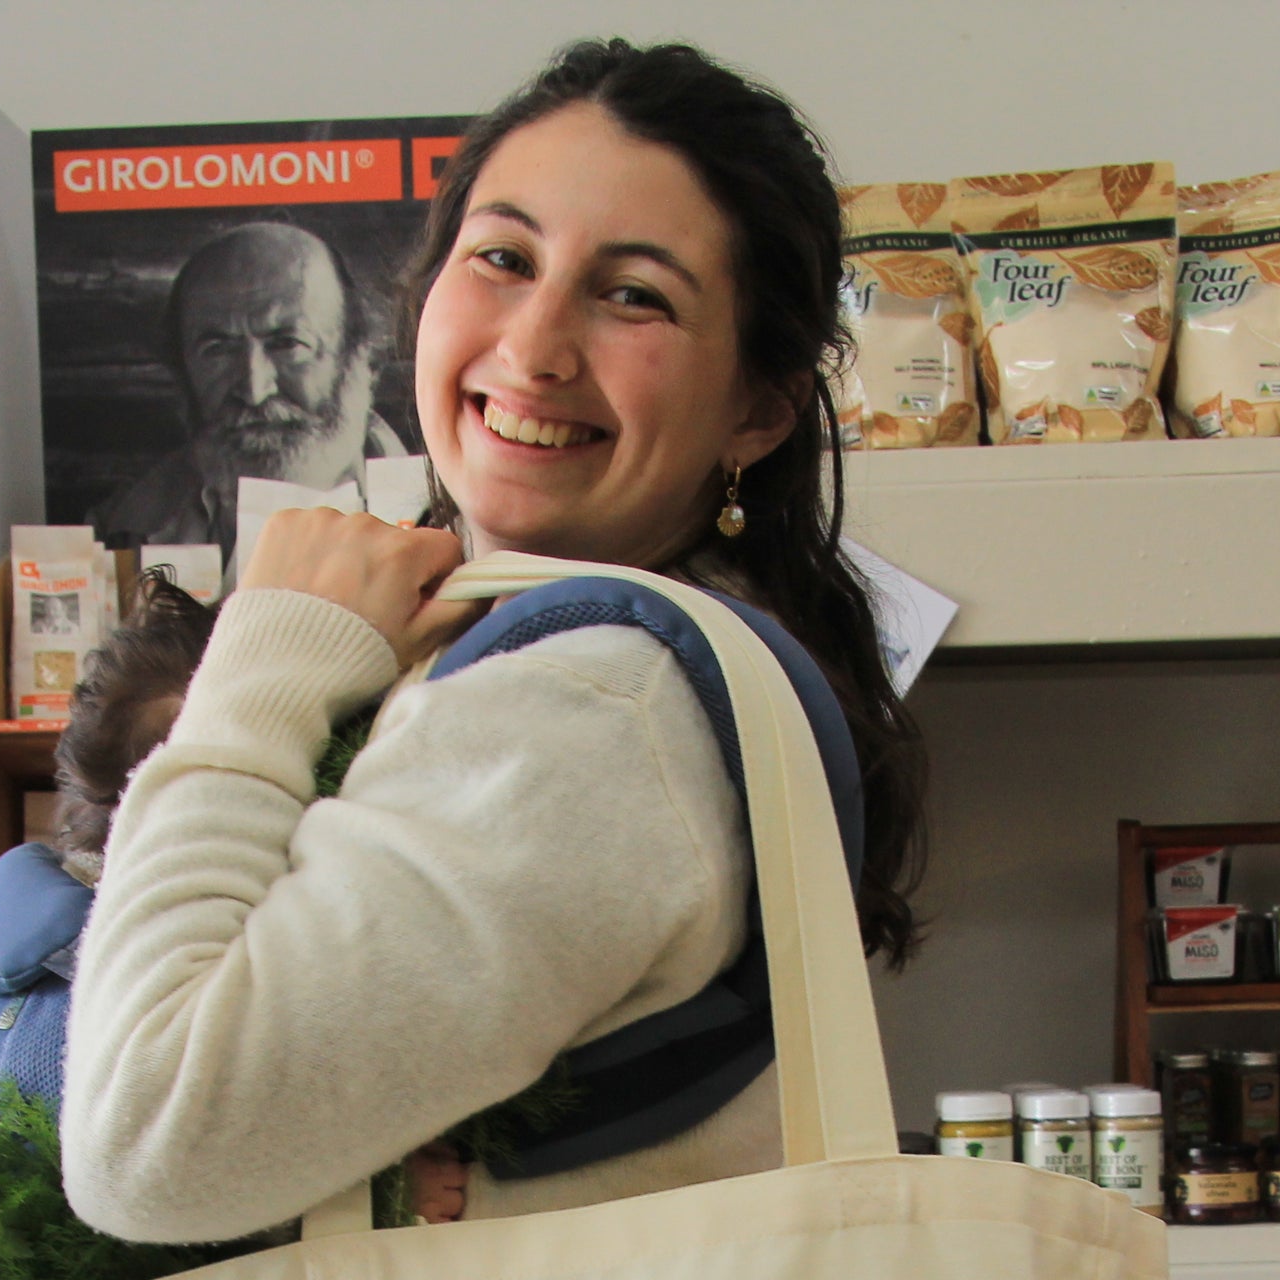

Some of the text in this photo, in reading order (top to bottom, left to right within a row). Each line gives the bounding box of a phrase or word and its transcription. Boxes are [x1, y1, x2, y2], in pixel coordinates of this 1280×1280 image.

[1000, 228, 1129, 248] CERTIFIED ORGANIC
[1193, 235, 1260, 249] CERTIFIED
[993, 257, 1057, 283] Four
[1177, 261, 1243, 285] Four
[1008, 275, 1071, 308] leaf
[1191, 275, 1257, 307] leaf
[1171, 876, 1205, 889] MISO
[1184, 945, 1220, 958] MISO
[1124, 1154, 1138, 1165] OF
